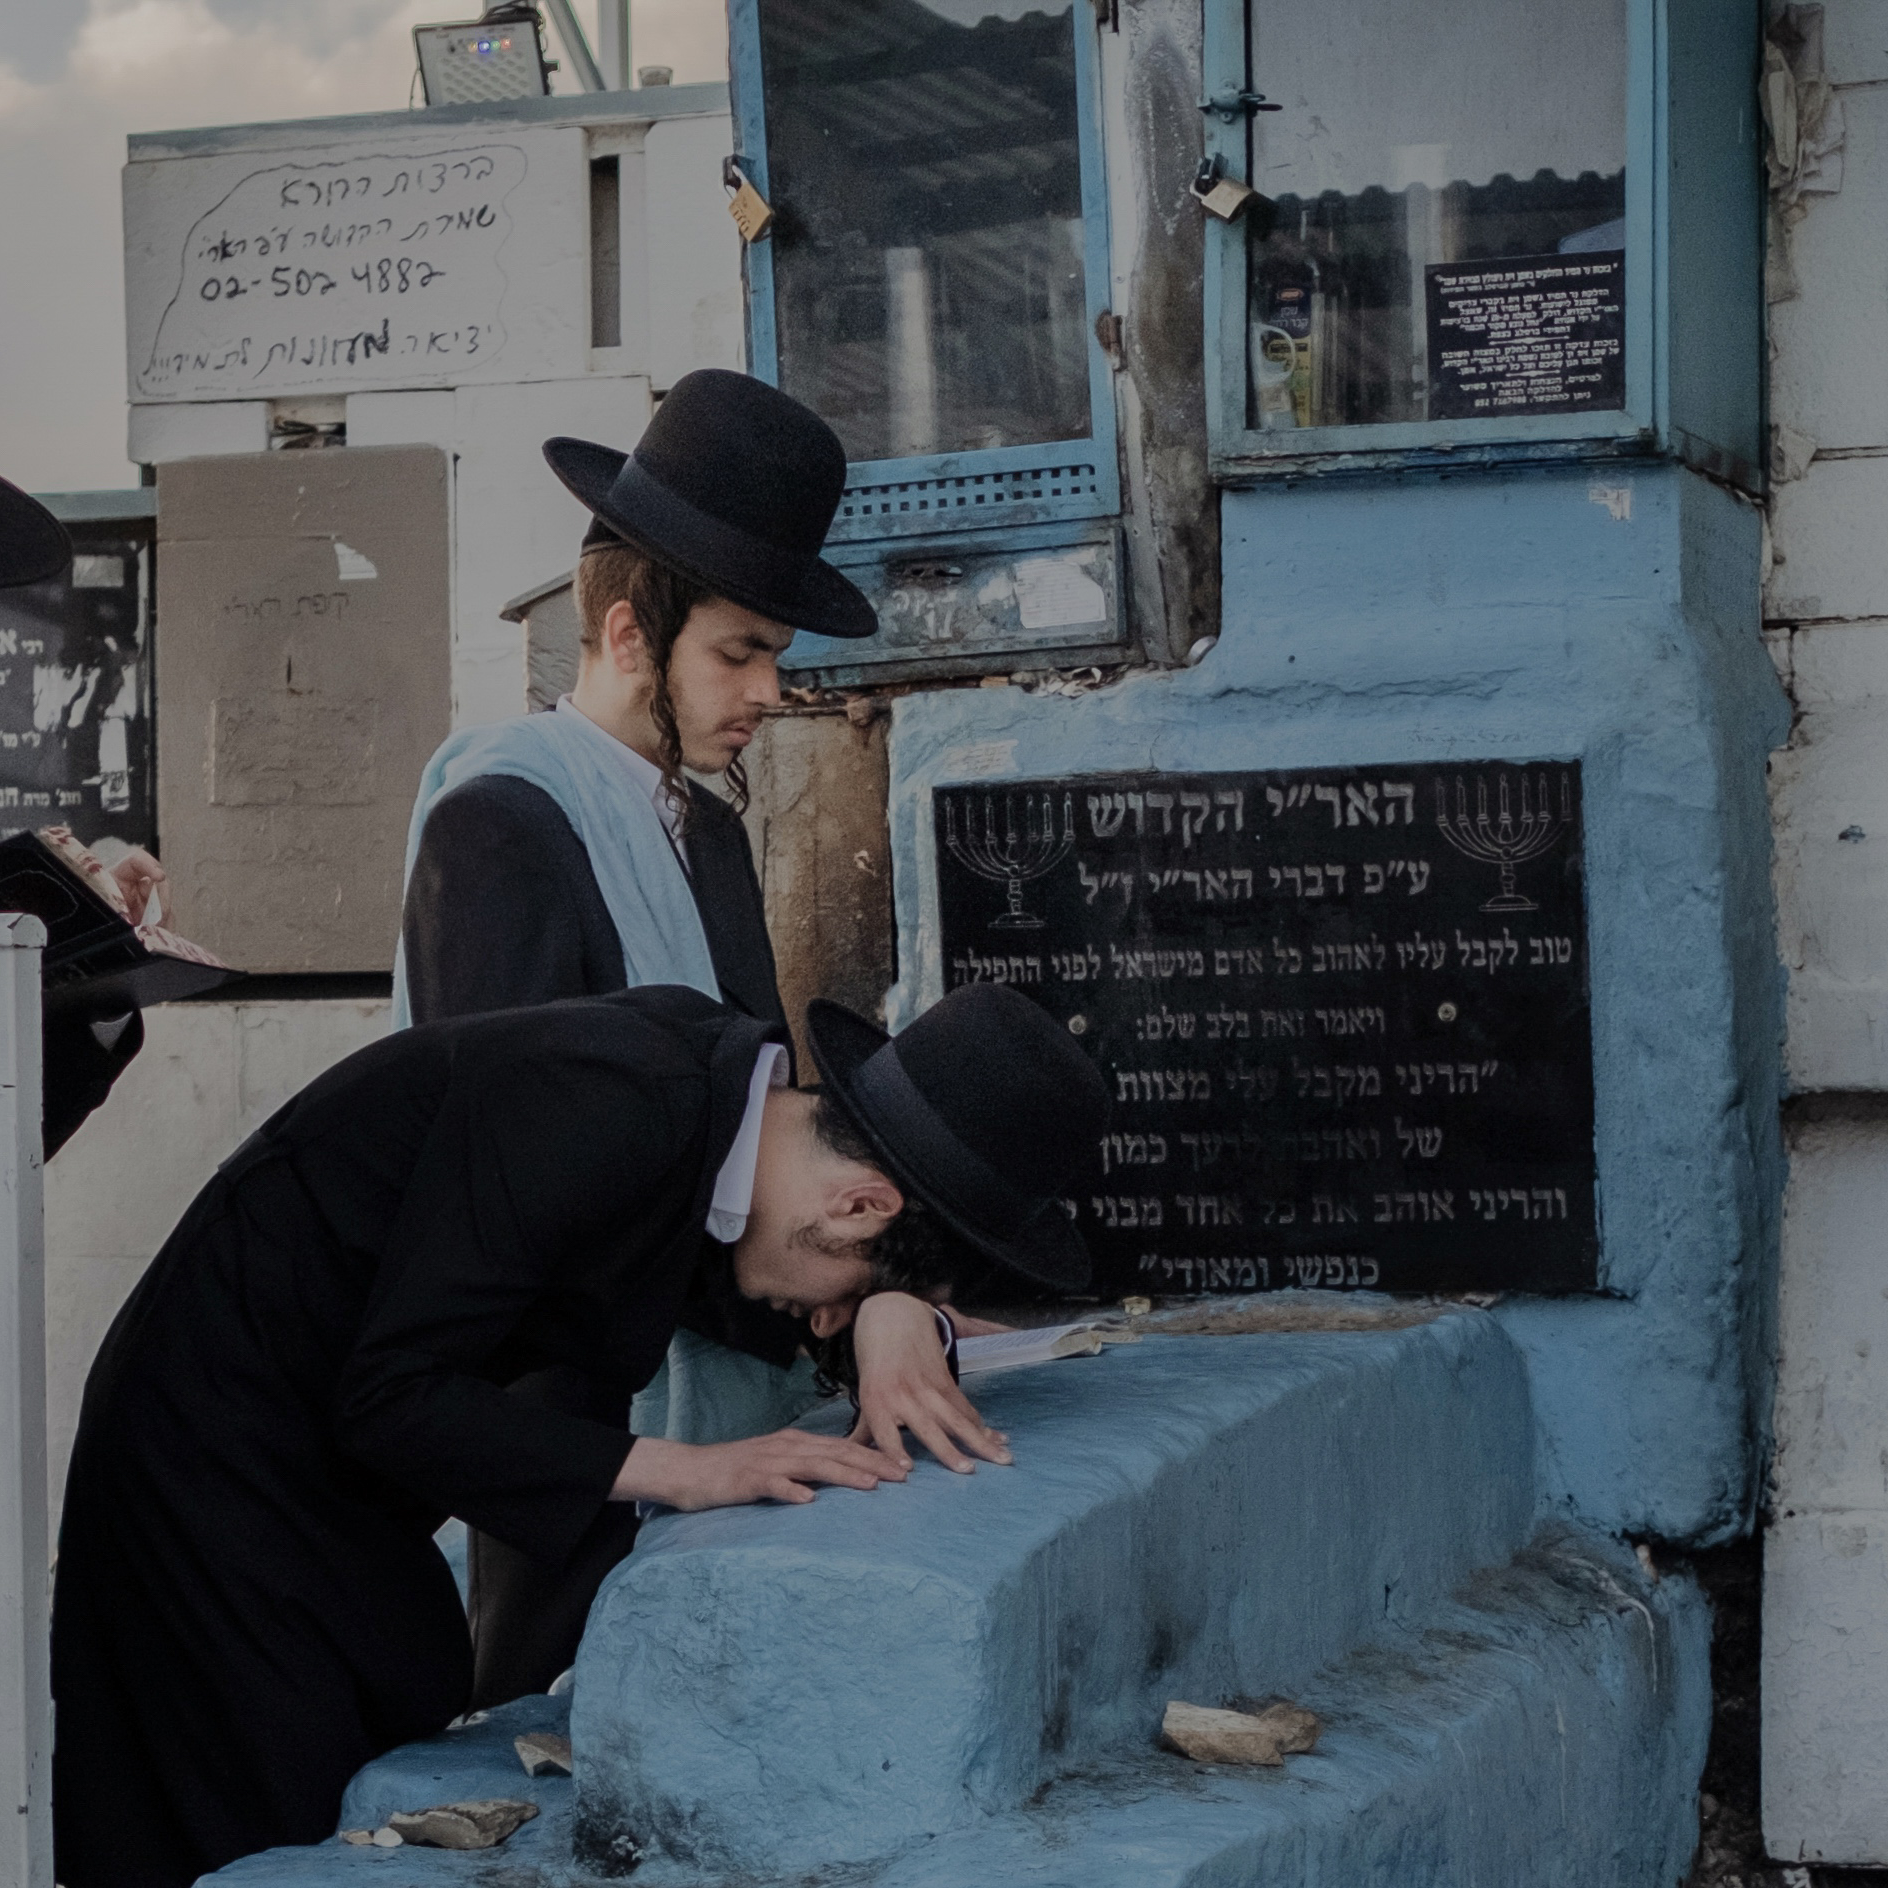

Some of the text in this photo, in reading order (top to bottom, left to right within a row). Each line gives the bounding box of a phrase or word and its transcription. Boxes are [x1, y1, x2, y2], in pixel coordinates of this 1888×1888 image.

[199, 256, 446, 303] 02-502 4882
[1087, 790, 1244, 846] הקדוש
[1268, 863, 1346, 897] דברי
[1050, 943, 1102, 982] לפני
[1109, 942, 1205, 980] מישראל
[1214, 949, 1263, 976] אדם
[1272, 936, 1302, 974] כל
[1312, 933, 1386, 973] לאהוב
[1396, 930, 1447, 971] עליו
[1455, 927, 1520, 975] לקבל
[1528, 936, 1572, 965] טוב
[1135, 1002, 1386, 1042] ויאמר זאת בלב שלם:
[1111, 1061, 1211, 1103] מצוות
[1297, 1057, 1381, 1106] מקבל
[1394, 1117, 1444, 1158] של
[1091, 1195, 1164, 1228] מבני
[1175, 1194, 1243, 1226] אחד
[1312, 1198, 1358, 1224] את
[1373, 1190, 1455, 1223] אוהב
[1468, 1187, 1568, 1221] והריני
[1283, 1255, 1380, 1292] כנפשי
